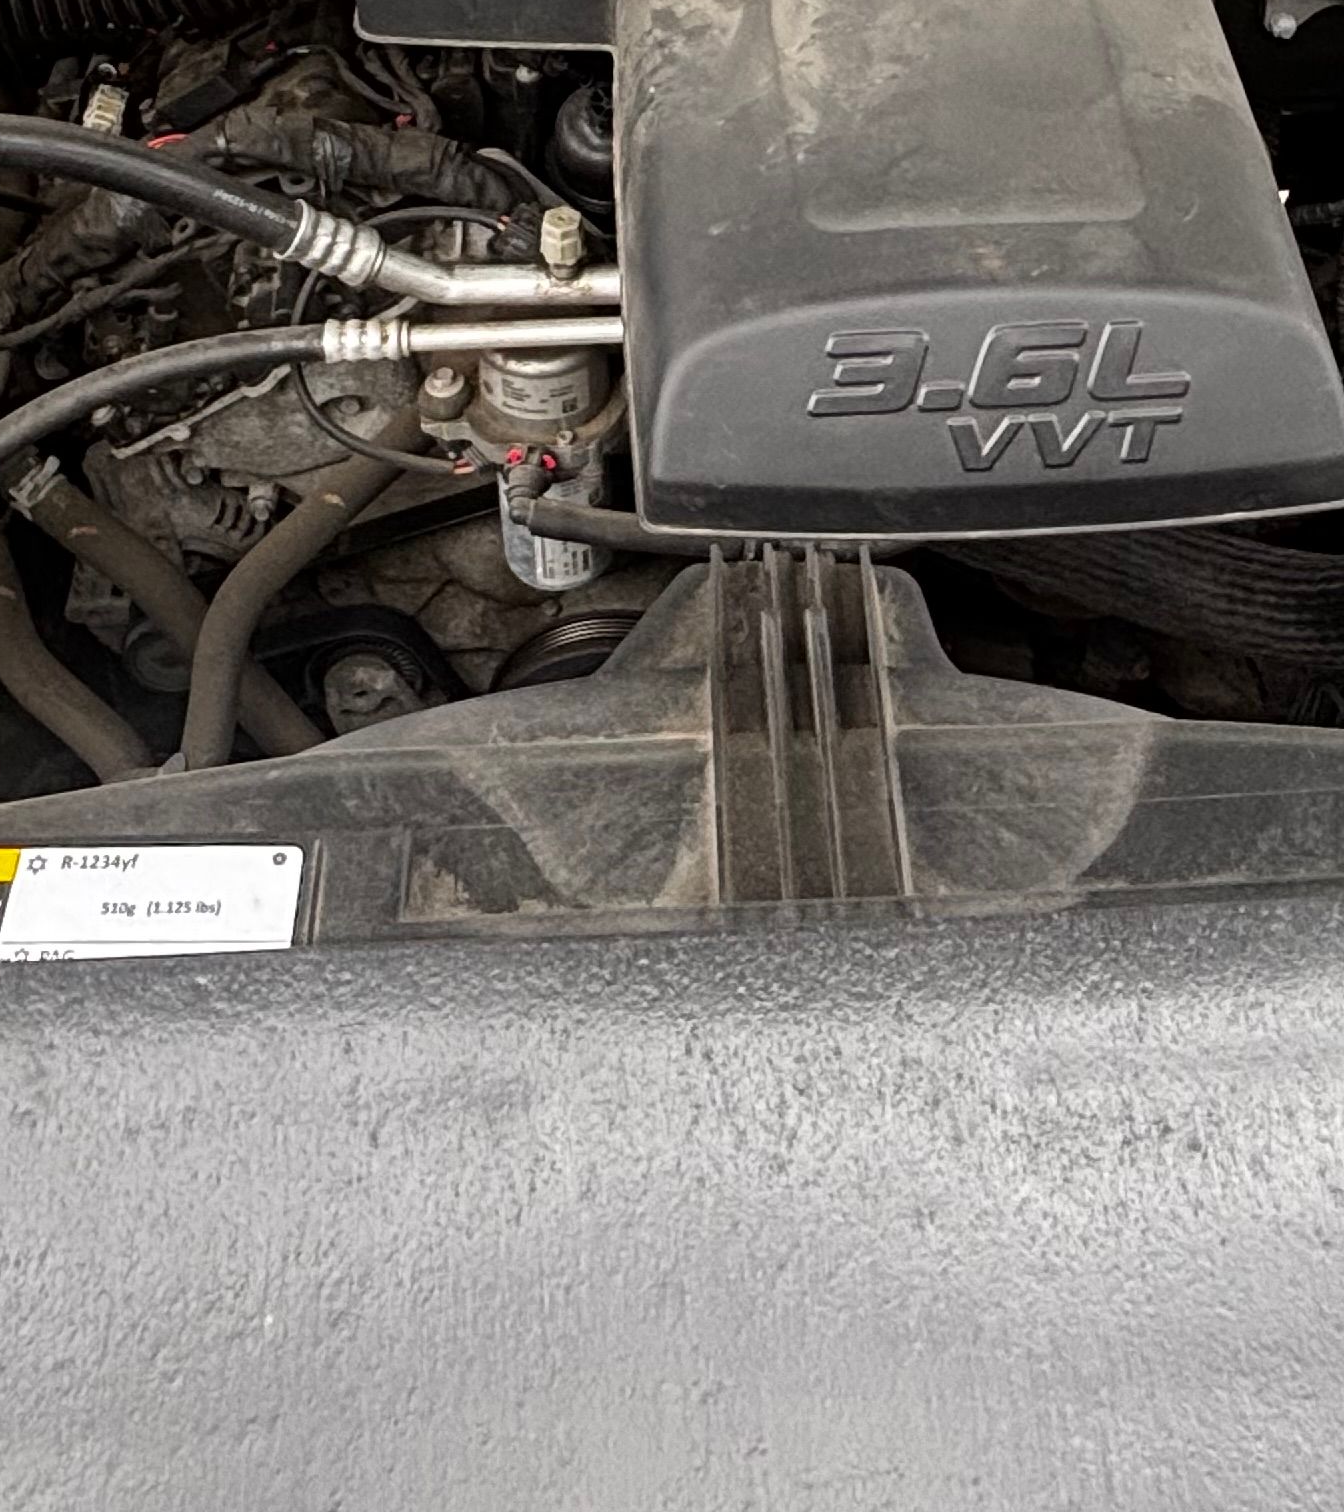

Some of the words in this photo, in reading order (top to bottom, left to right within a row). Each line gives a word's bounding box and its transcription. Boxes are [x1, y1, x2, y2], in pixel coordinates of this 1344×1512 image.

[807, 318, 1191, 418] 3.6L
[946, 406, 1184, 473] VVT
[60, 854, 140, 873] R-1234yf
[100, 901, 137, 917] 510g
[146, 900, 192, 917] (1.125
[194, 899, 222, 917] lbs)
